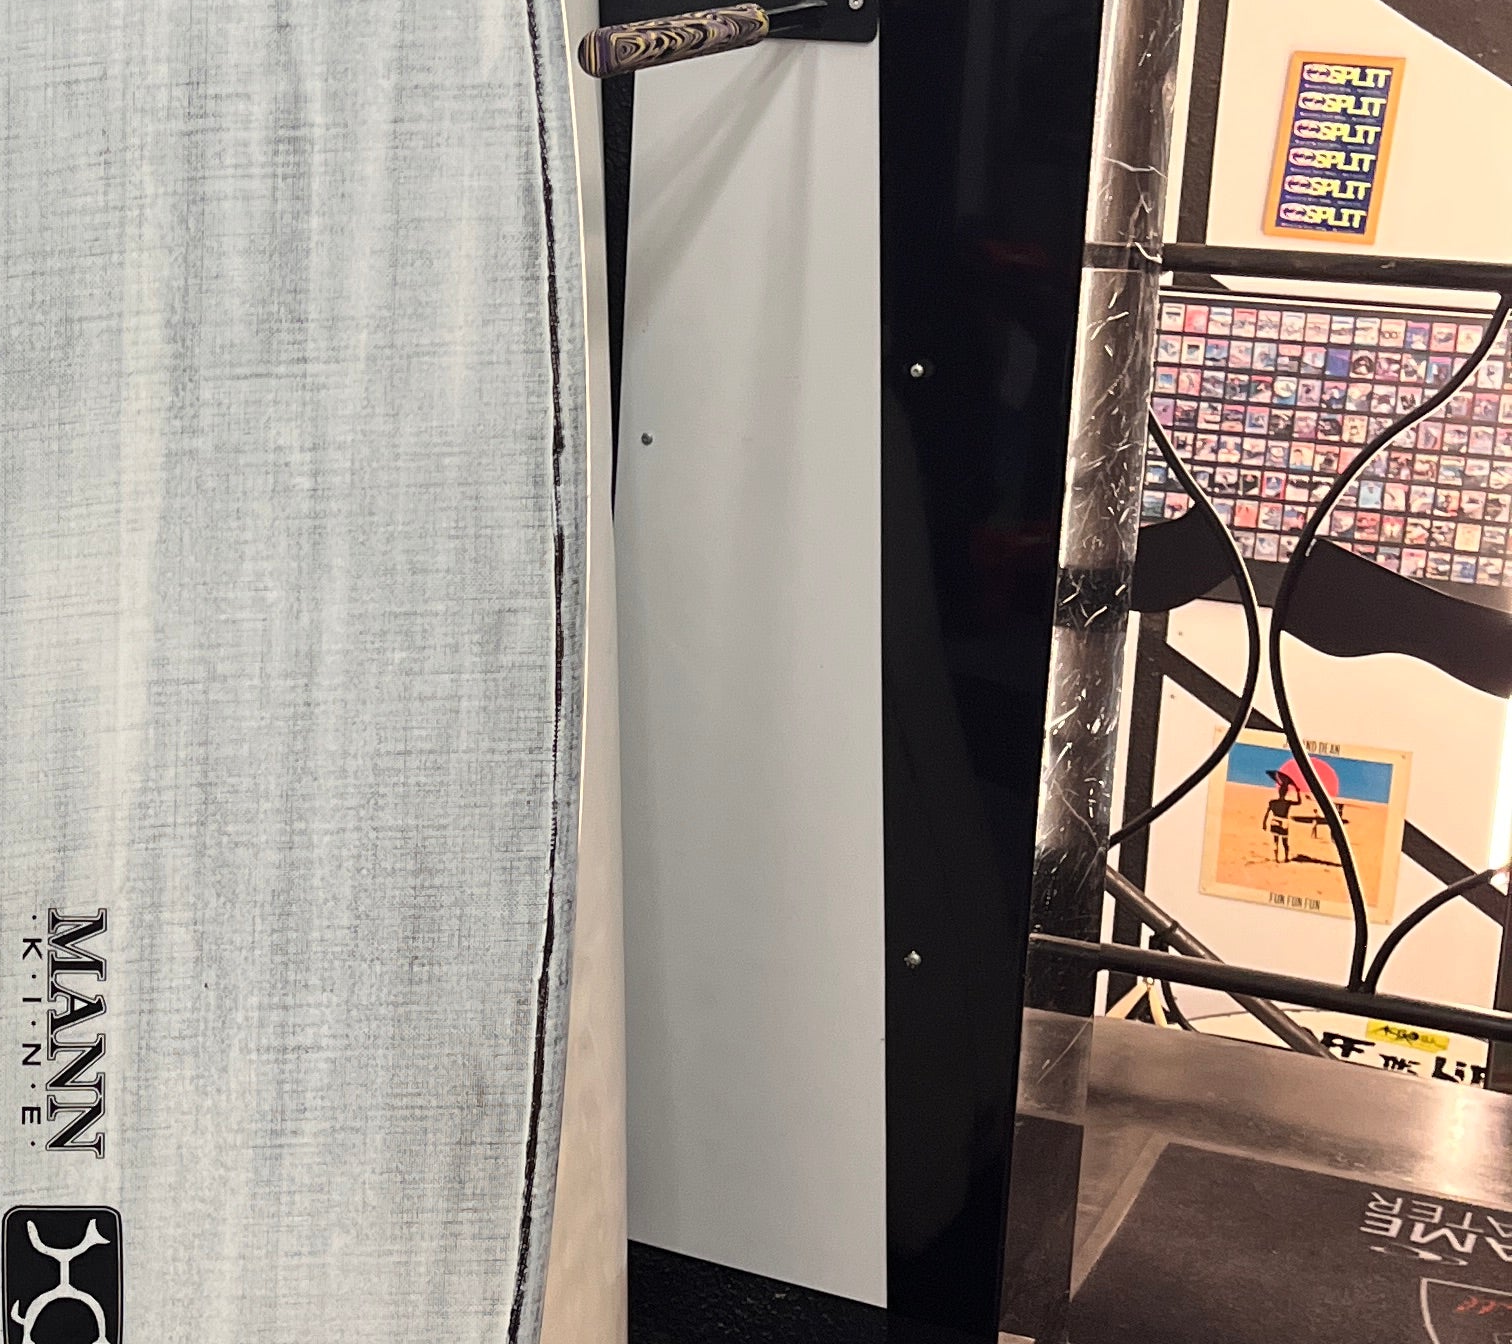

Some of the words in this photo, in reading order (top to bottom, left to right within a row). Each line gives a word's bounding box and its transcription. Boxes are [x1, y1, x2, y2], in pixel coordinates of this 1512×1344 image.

[1328, 64, 1392, 89] SPLIT
[1323, 94, 1387, 117] SPLIT
[1319, 121, 1381, 145] SPLIT
[1314, 149, 1376, 173] SPLIT
[1309, 177, 1372, 201] SPLIT
[1304, 205, 1367, 229] SPLIT
[46, 908, 108, 1159] MANN
